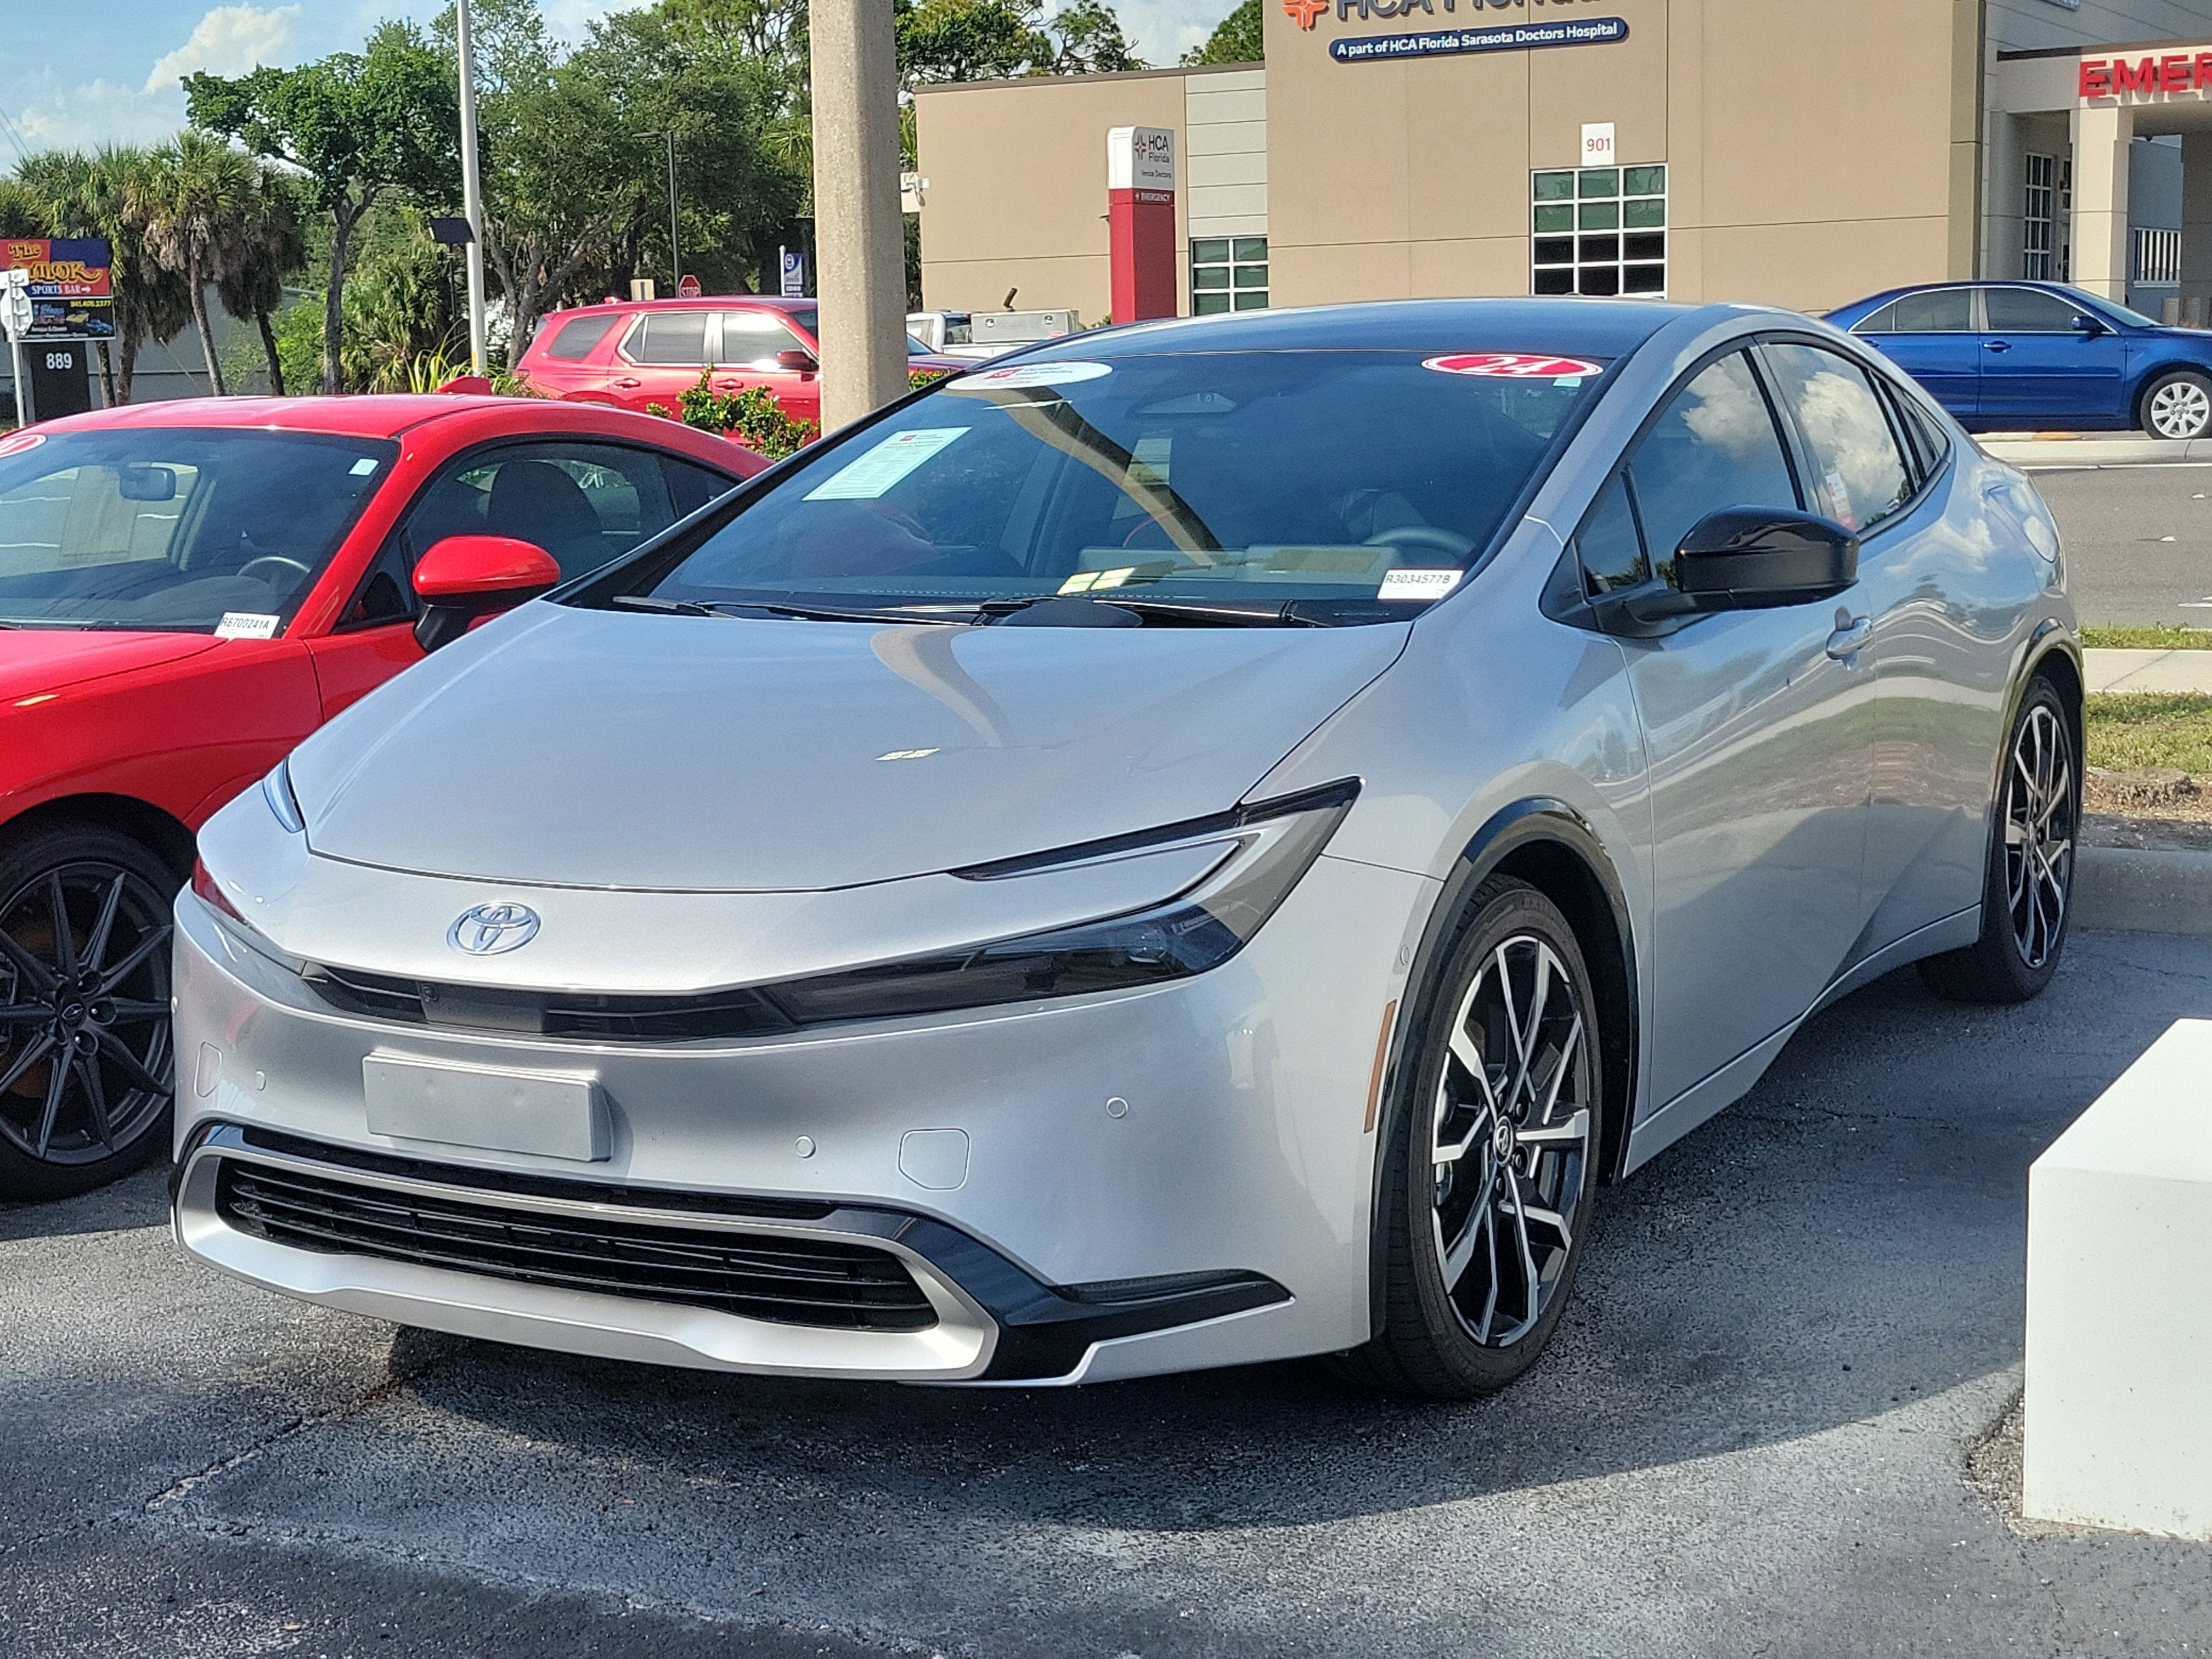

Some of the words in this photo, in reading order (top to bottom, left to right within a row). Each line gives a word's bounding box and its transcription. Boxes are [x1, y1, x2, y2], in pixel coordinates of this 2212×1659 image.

[1337, 44, 1347, 55] A
[1348, 43, 1374, 57] part
[1374, 40, 1389, 53] of
[1390, 38, 1417, 52] HCA
[1419, 36, 1459, 50] Florida
[1462, 32, 1514, 46] Sarasota
[1515, 28, 1564, 42] Doctors
[1567, 22, 1617, 40] Hospital
[1149, 134, 1169, 151] HCA
[1587, 137, 1610, 151] 901
[1149, 153, 1169, 163] Florida
[8, 242, 42, 260] The
[31, 285, 63, 295] SPORTS
[65, 284, 82, 295] BAR
[46, 352, 72, 369] 889
[1459, 356, 1565, 375] 24
